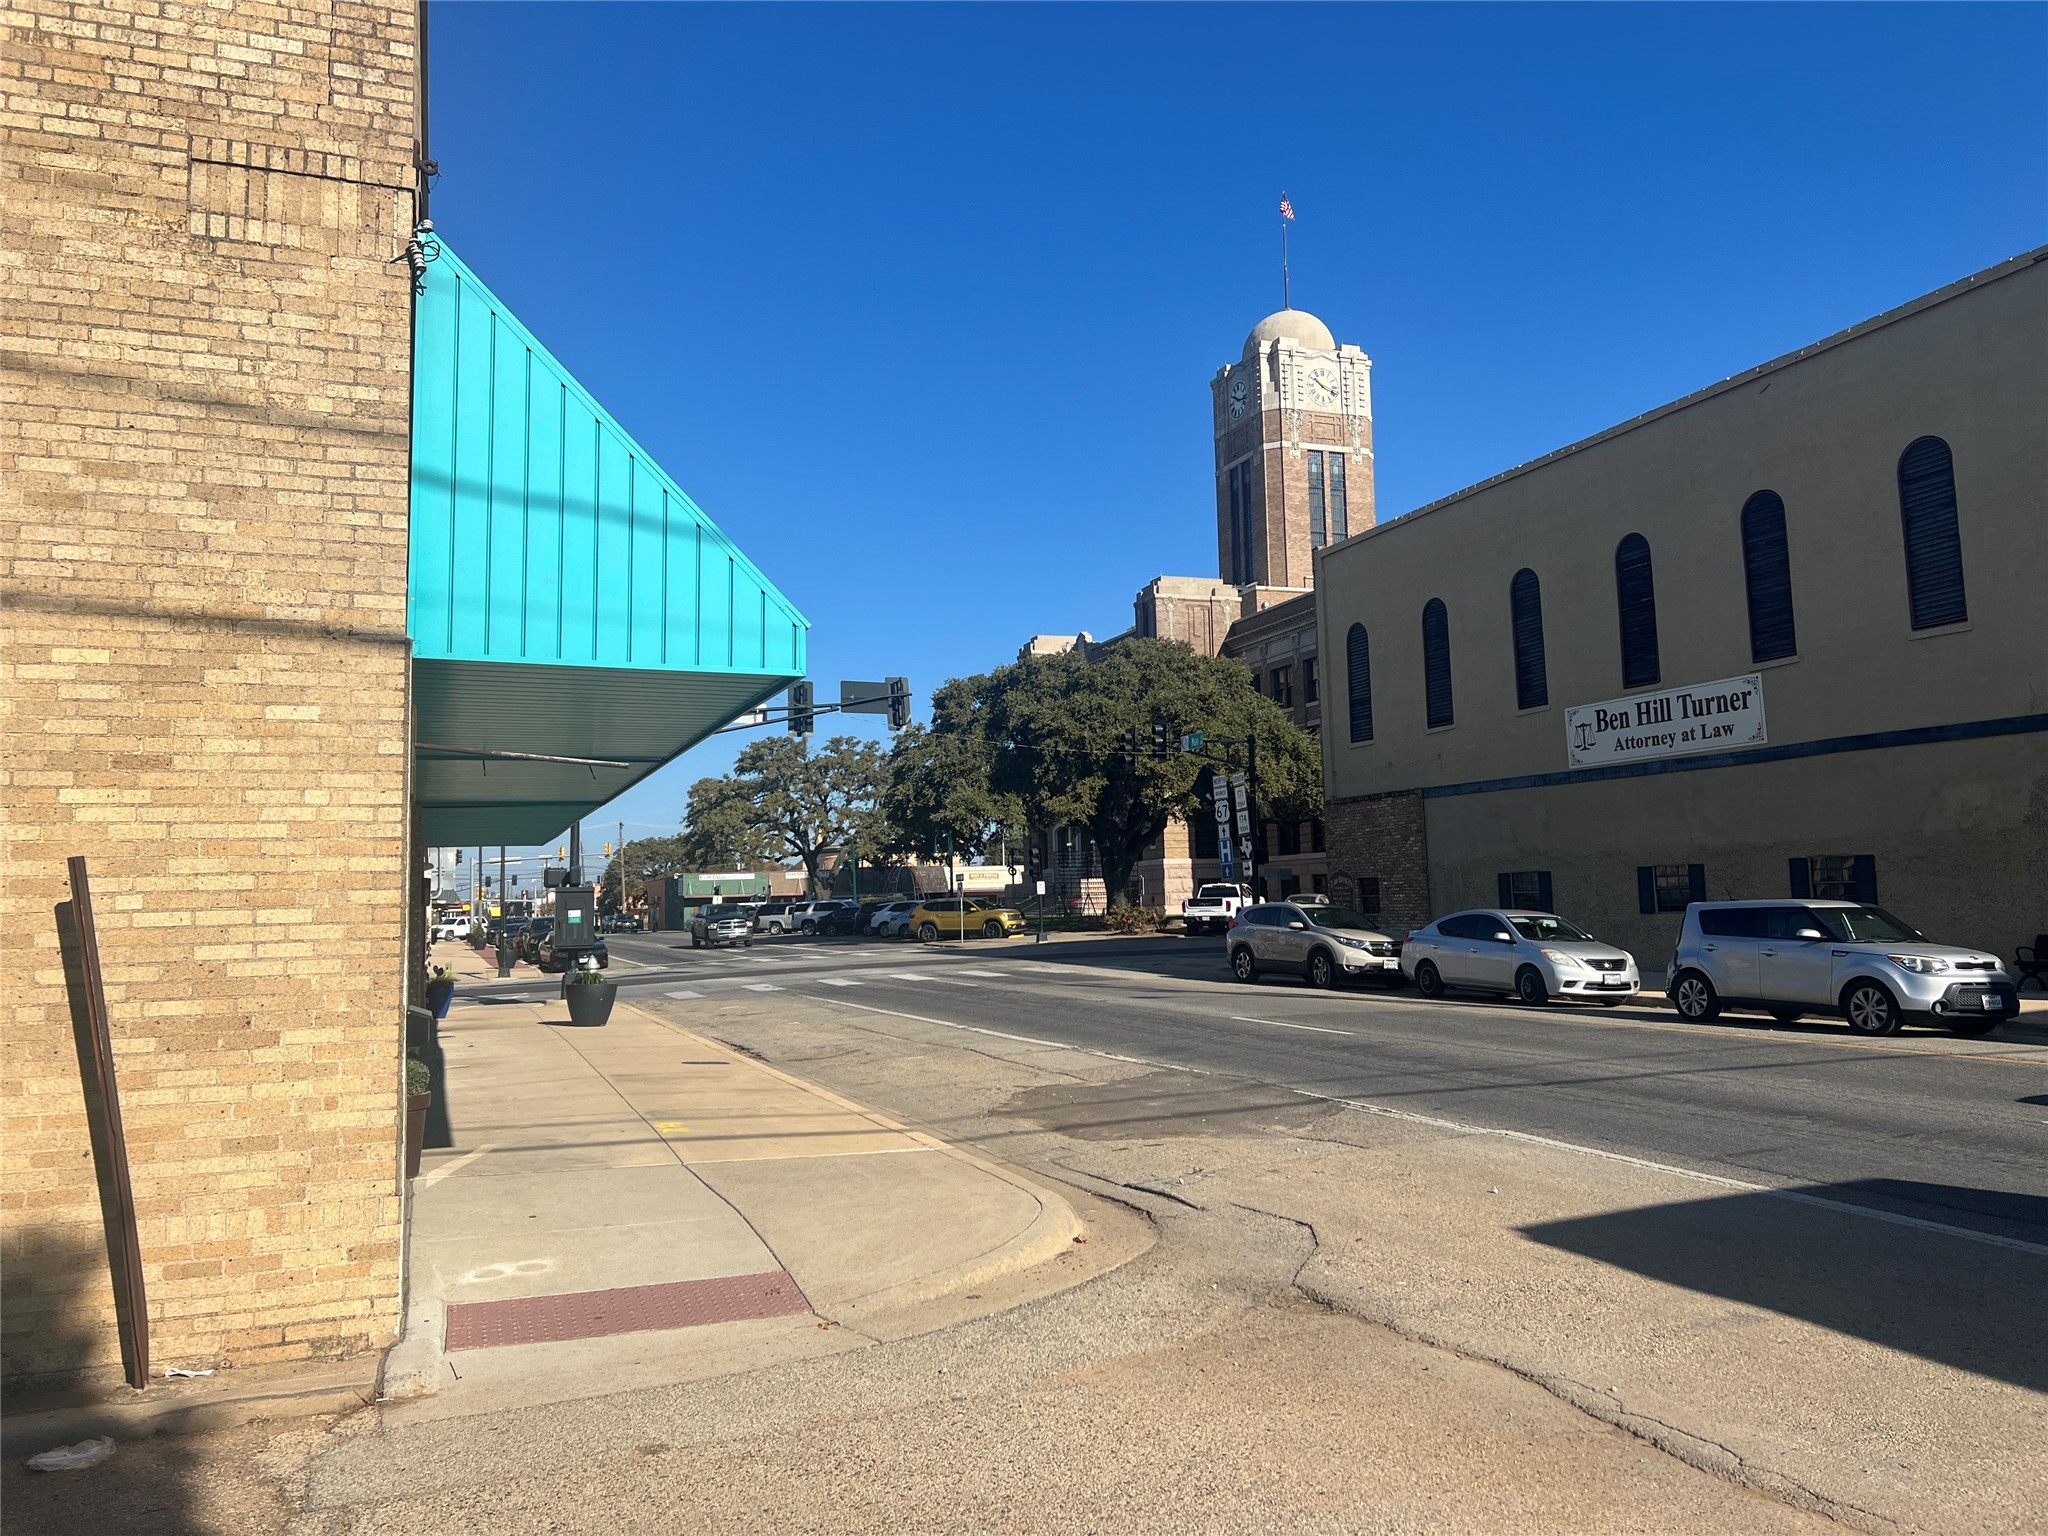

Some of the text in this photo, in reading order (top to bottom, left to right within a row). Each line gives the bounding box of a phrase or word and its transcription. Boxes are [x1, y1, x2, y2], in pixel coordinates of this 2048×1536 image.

[1594, 689, 1752, 733] Ben Hill Turner
[1613, 723, 1735, 752] Attorney at Law
[1216, 804, 1228, 818] 67
[1238, 814, 1247, 824] 174
[1220, 840, 1231, 863] H
